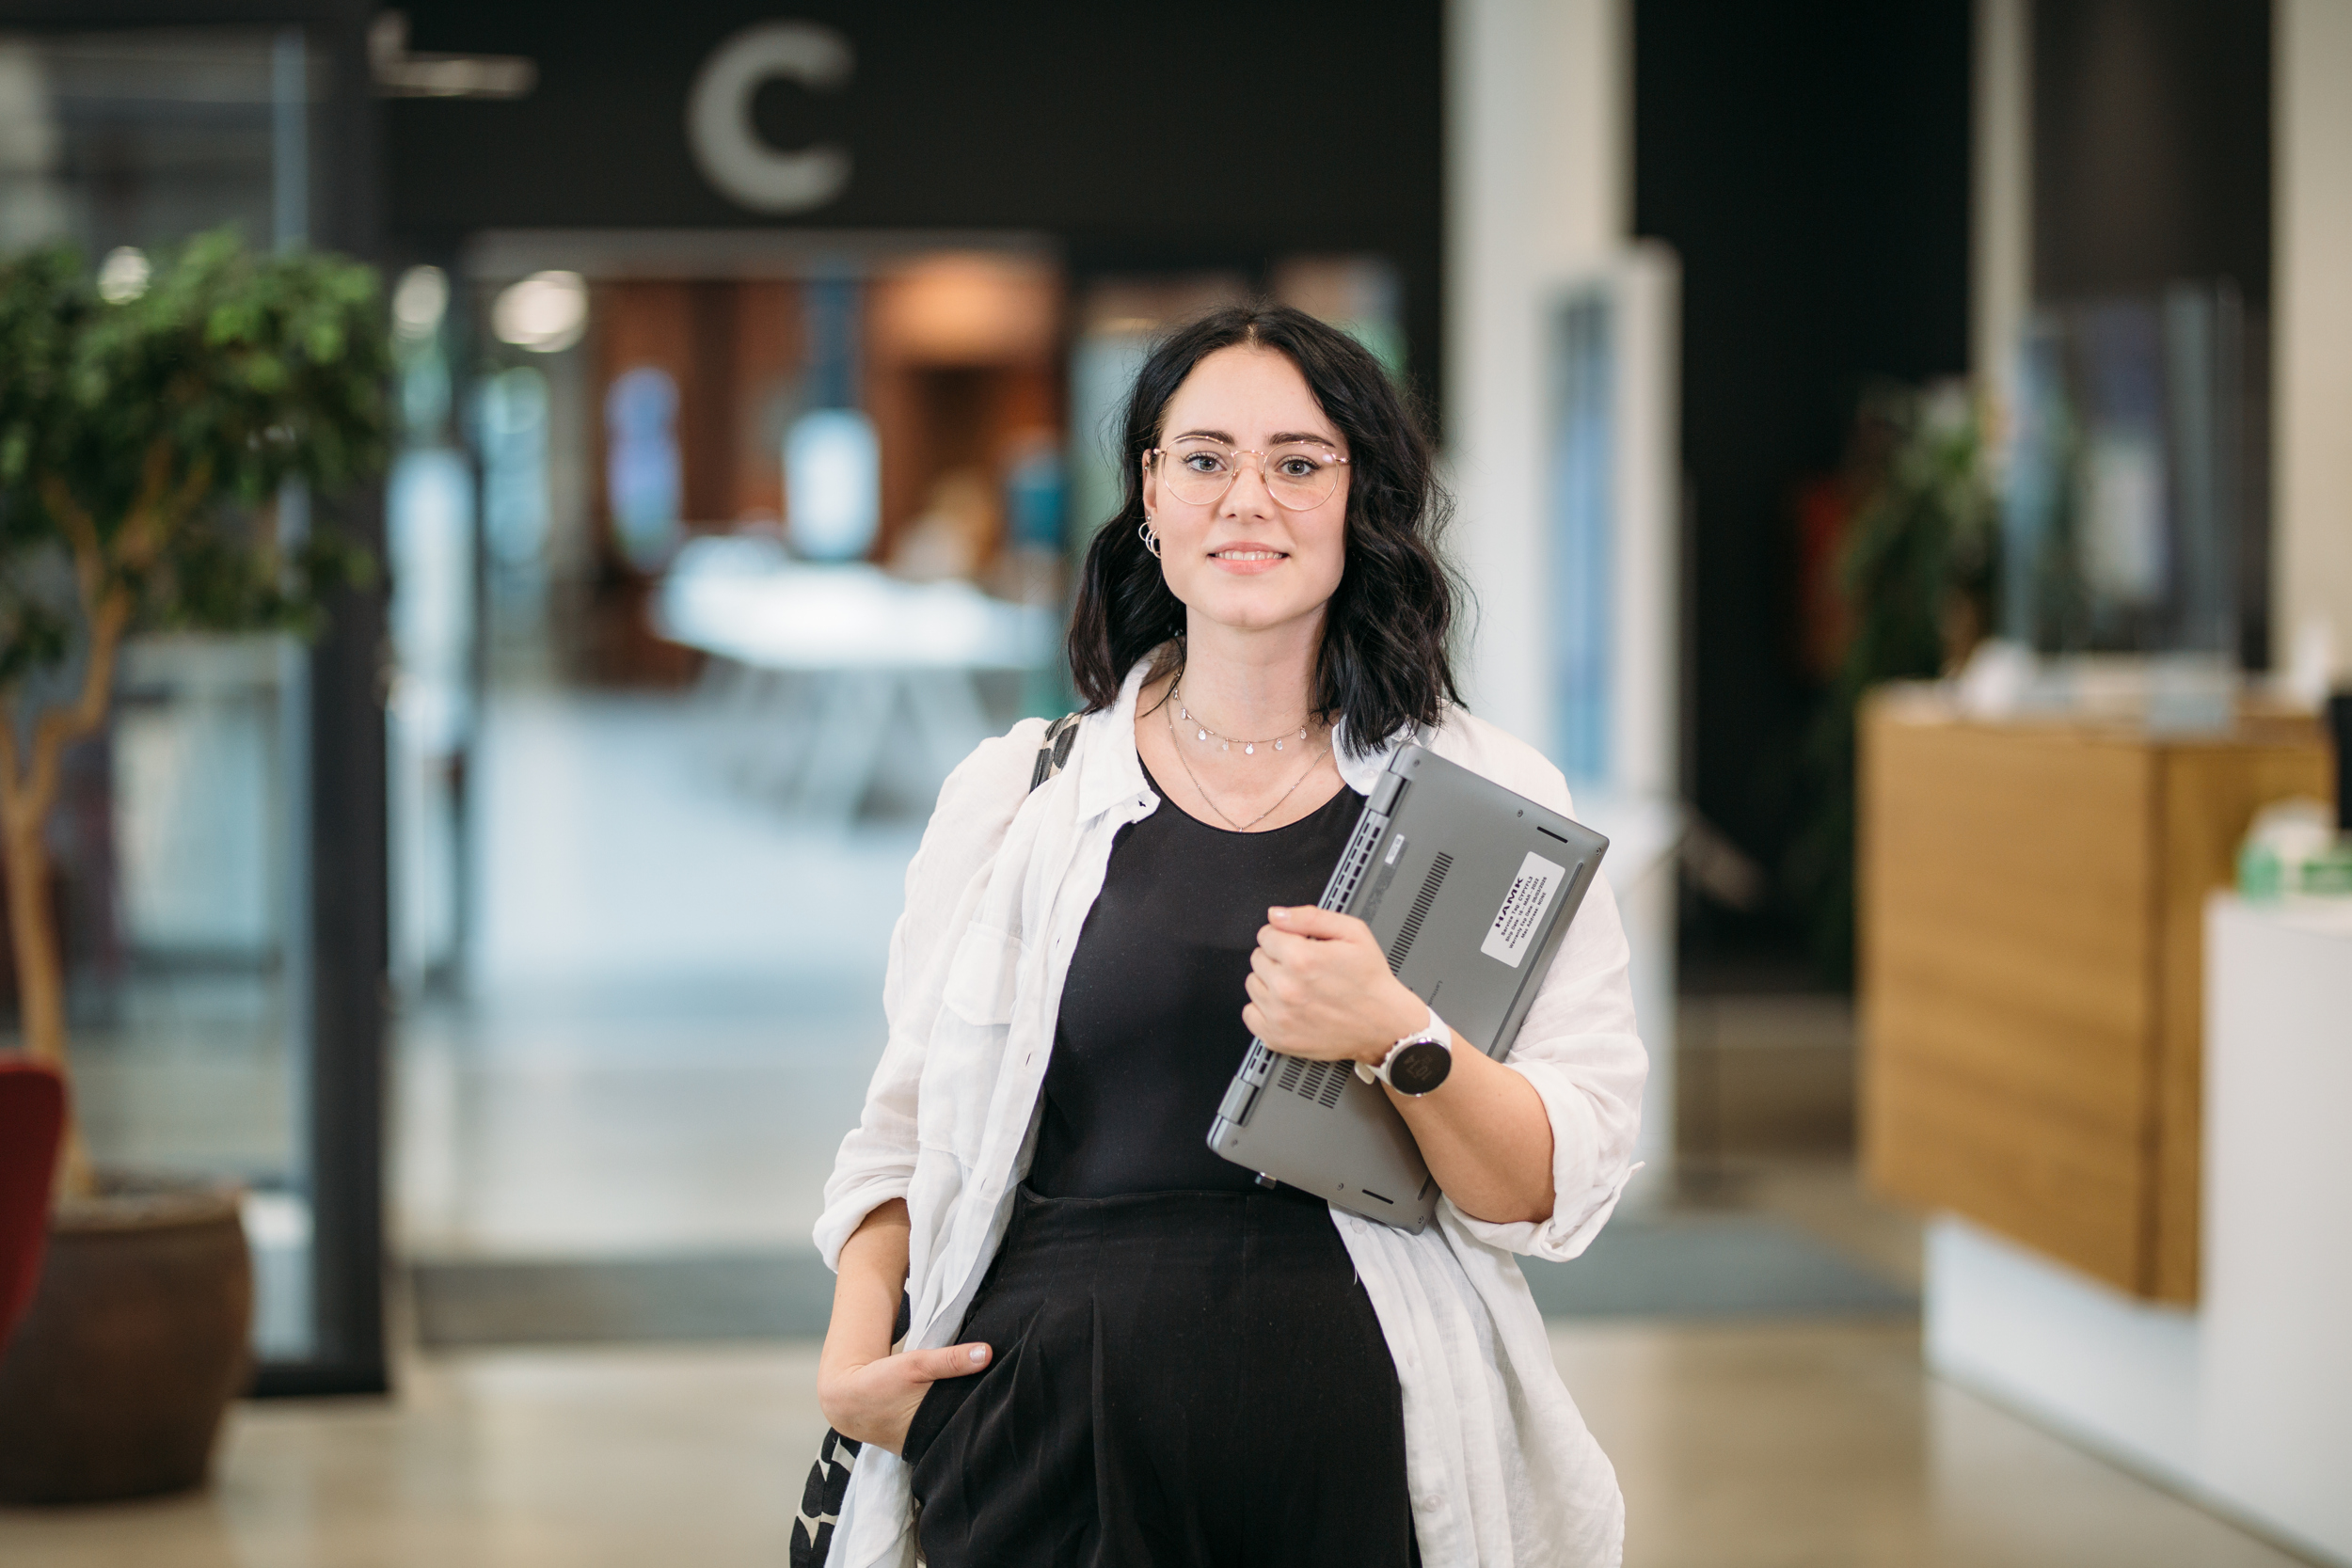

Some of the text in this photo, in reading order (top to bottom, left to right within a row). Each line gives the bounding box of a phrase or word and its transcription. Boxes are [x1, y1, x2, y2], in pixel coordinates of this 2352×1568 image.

[687, 21, 854, 210] C
[1494, 877, 1523, 927] HAMK
[1526, 906, 1539, 927] Address:
[1501, 915, 1513, 936] Service
[1510, 902, 1520, 914] Tag:
[1504, 930, 1513, 942] Ship
[1510, 917, 1519, 930] Date:
[1508, 927, 1522, 948] Warranty
